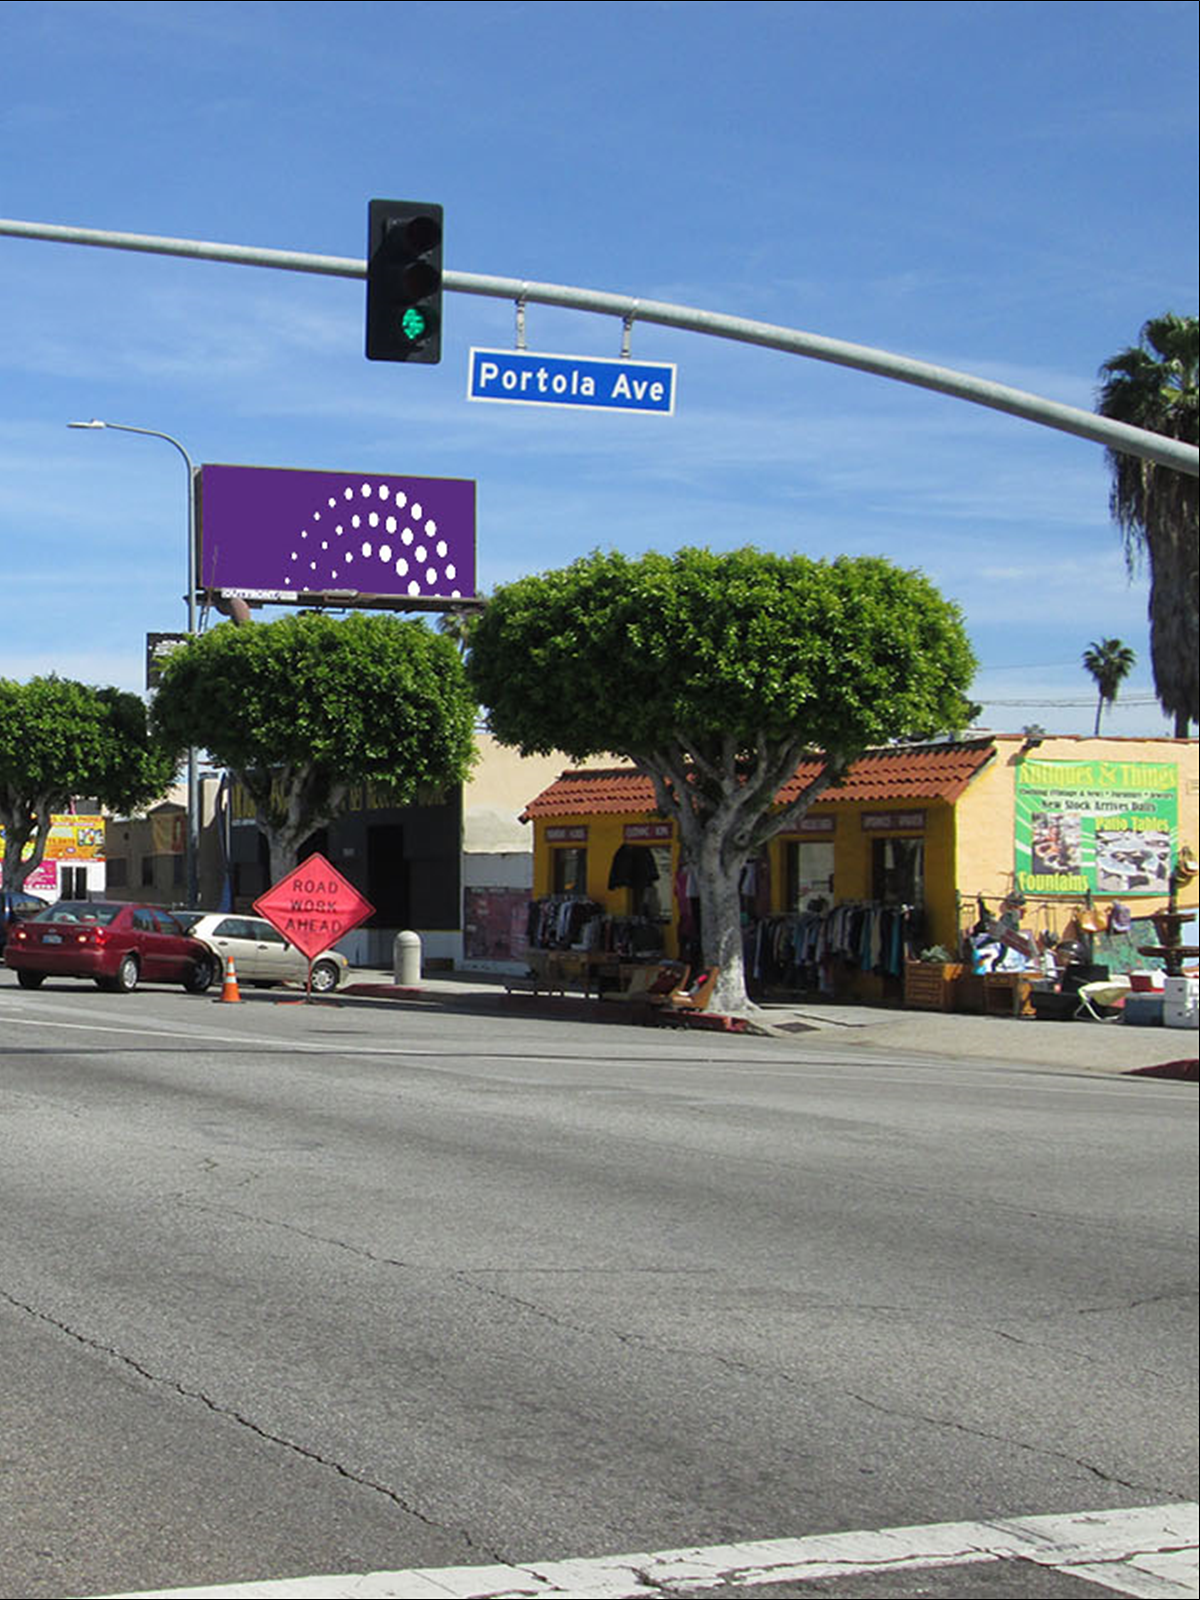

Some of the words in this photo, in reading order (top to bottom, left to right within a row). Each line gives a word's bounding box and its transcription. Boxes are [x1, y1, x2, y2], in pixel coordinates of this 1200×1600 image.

[479, 362, 596, 397] Portola
[611, 373, 665, 402] Ave
[292, 879, 338, 894] ROAD
[290, 899, 337, 914] WORK
[285, 918, 341, 933] AHEAD
